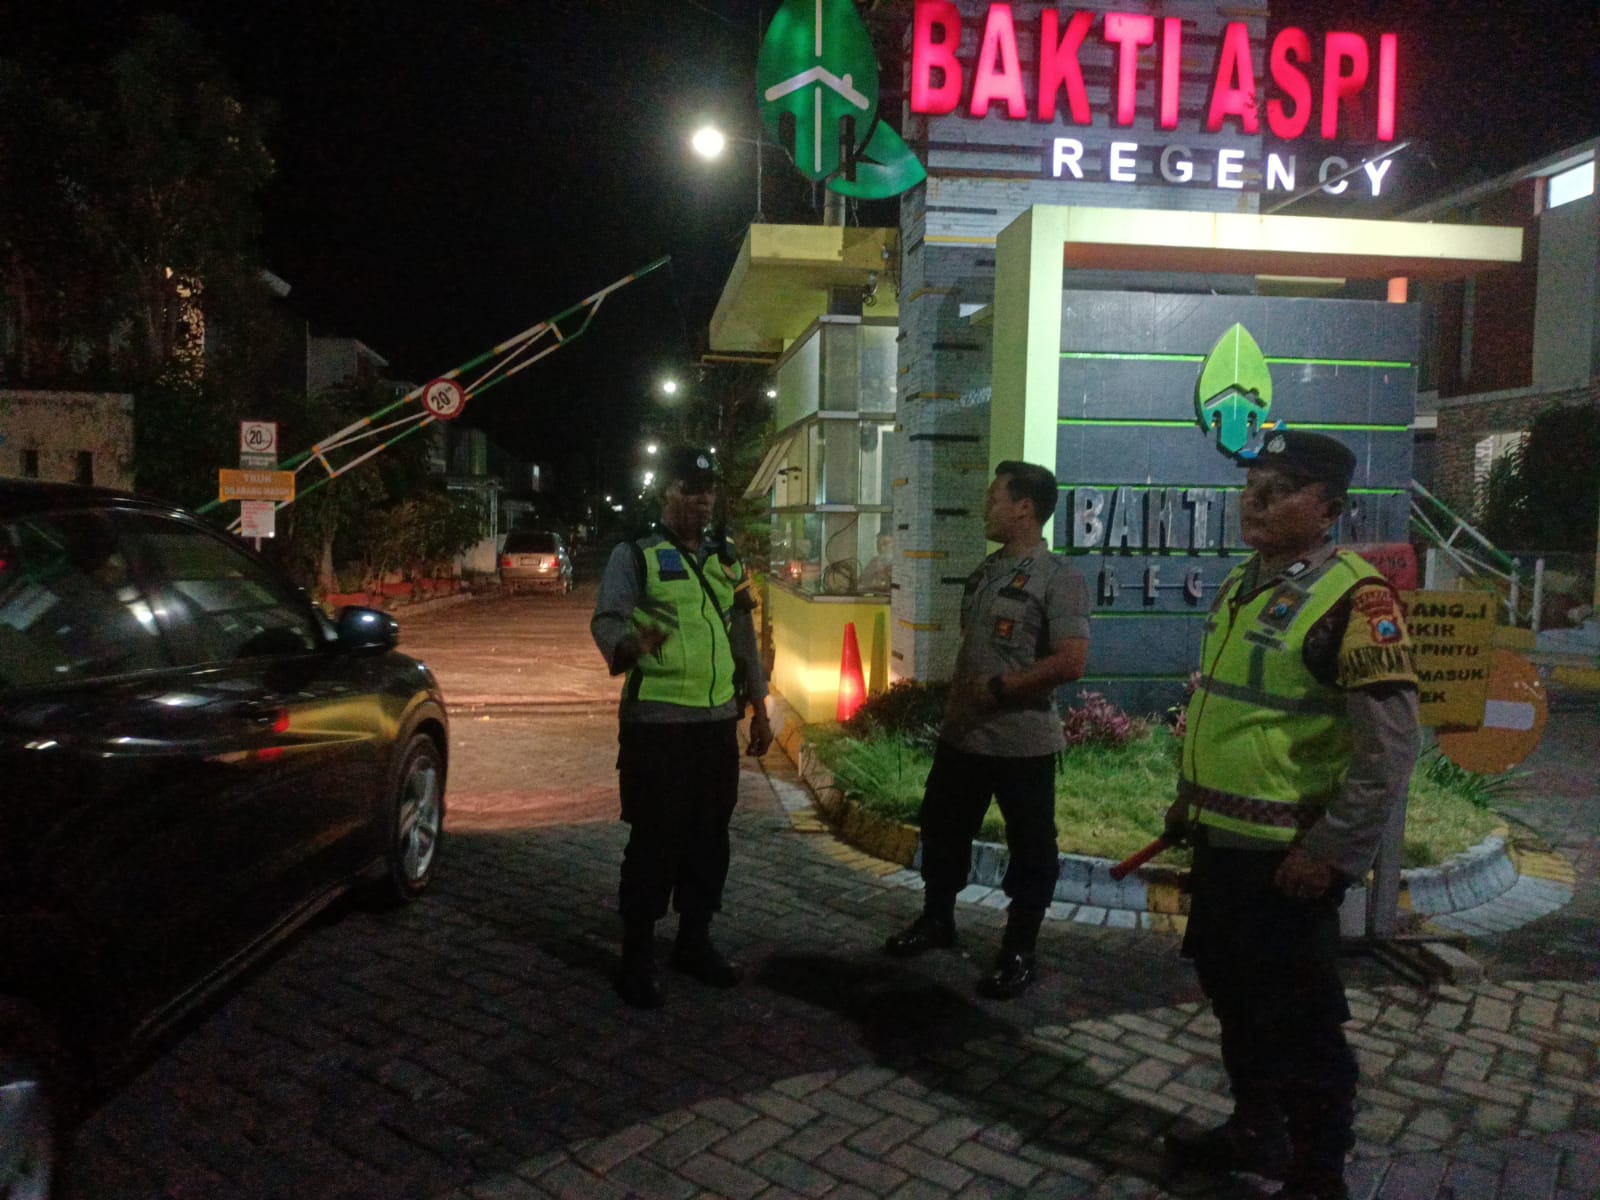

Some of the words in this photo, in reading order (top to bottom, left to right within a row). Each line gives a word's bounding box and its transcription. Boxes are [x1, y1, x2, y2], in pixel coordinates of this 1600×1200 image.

[910, 0, 1183, 130] BAKTI
[1206, 21, 1398, 141] ASPI
[1052, 137, 1393, 197] REGENCY
[430, 391, 451, 411] 20
[249, 430, 262, 444] 20
[1421, 644, 1479, 657] PINTU
